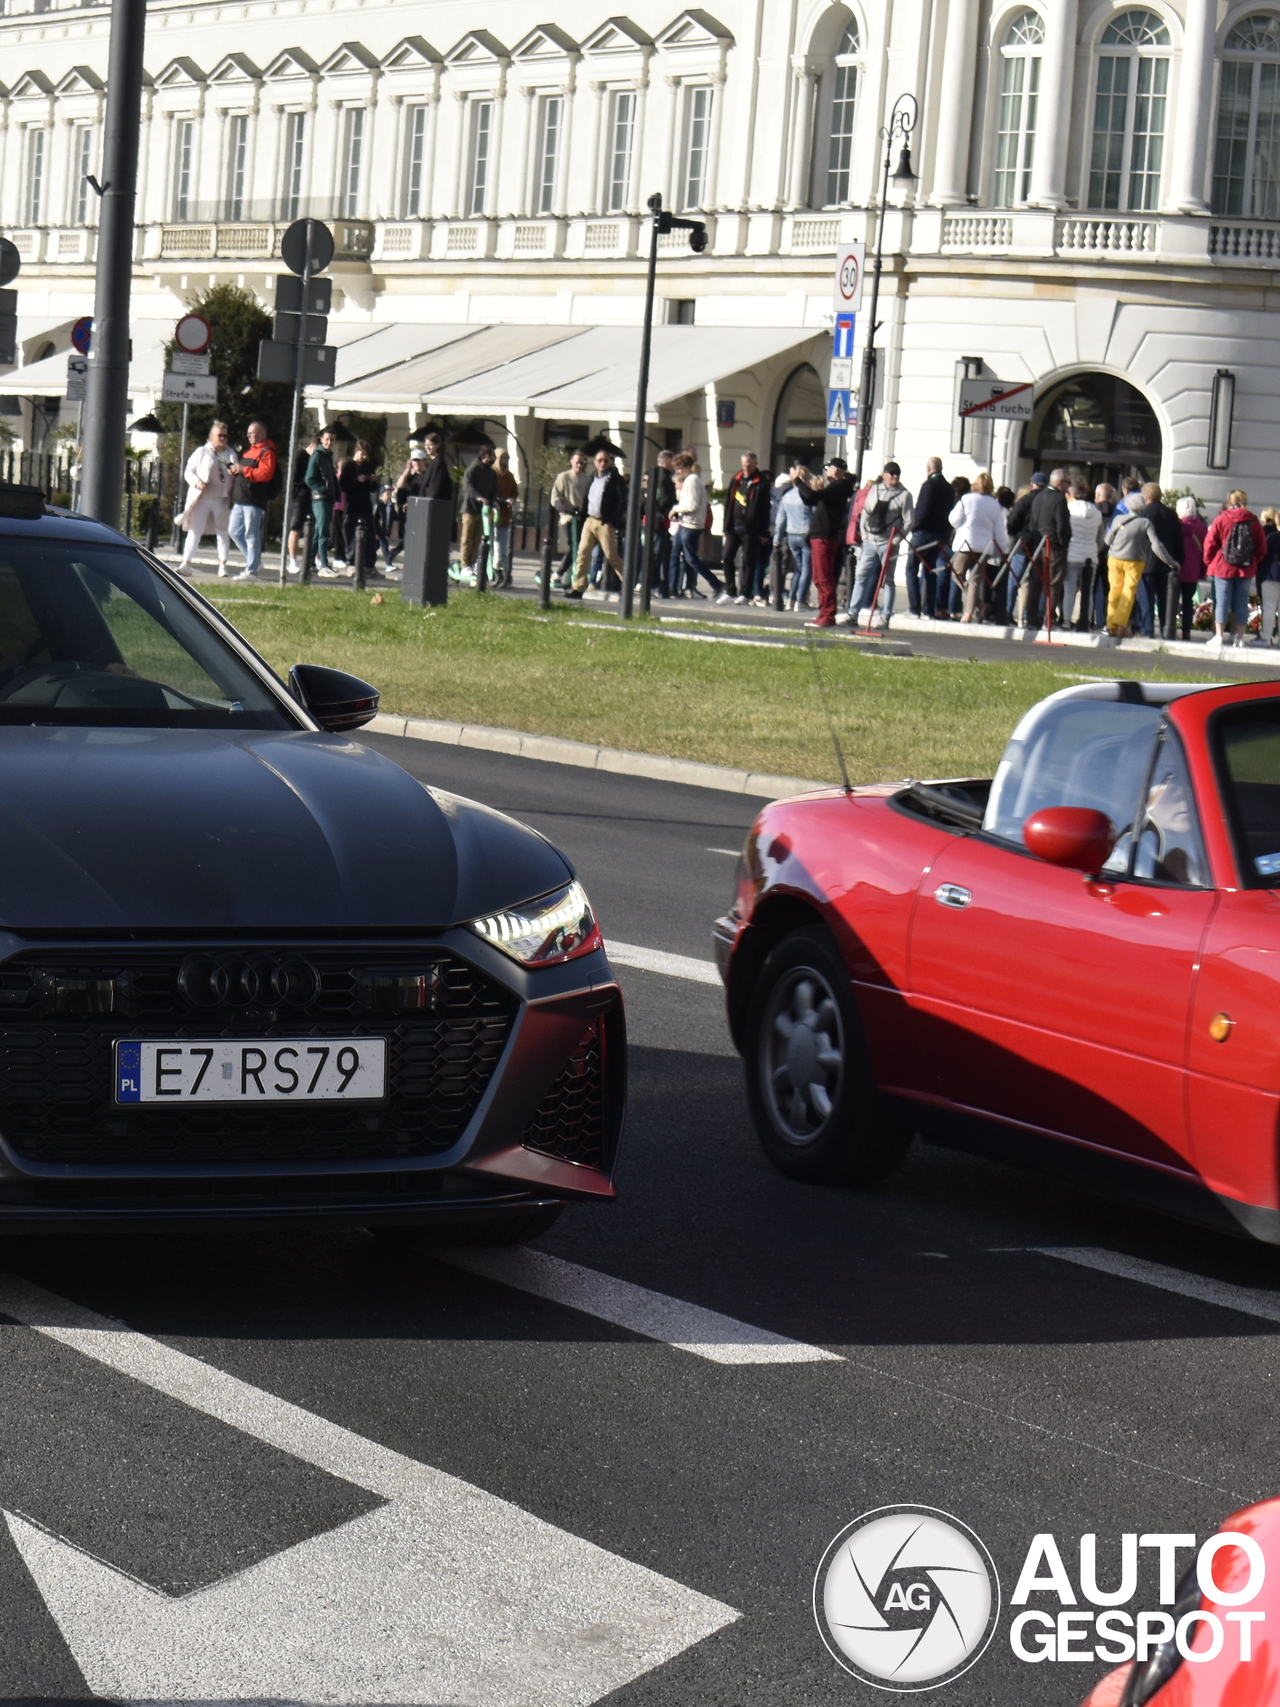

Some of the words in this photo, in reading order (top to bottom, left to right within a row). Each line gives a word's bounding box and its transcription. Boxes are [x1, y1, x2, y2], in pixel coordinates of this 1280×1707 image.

[842, 267, 856, 287] 30
[165, 389, 190, 399] Strefa
[193, 392, 216, 400] ruchu
[1001, 403, 1031, 415] ruchu
[155, 1047, 215, 1096] E7
[240, 1046, 360, 1095] RS79
[121, 1079, 138, 1092] PL
